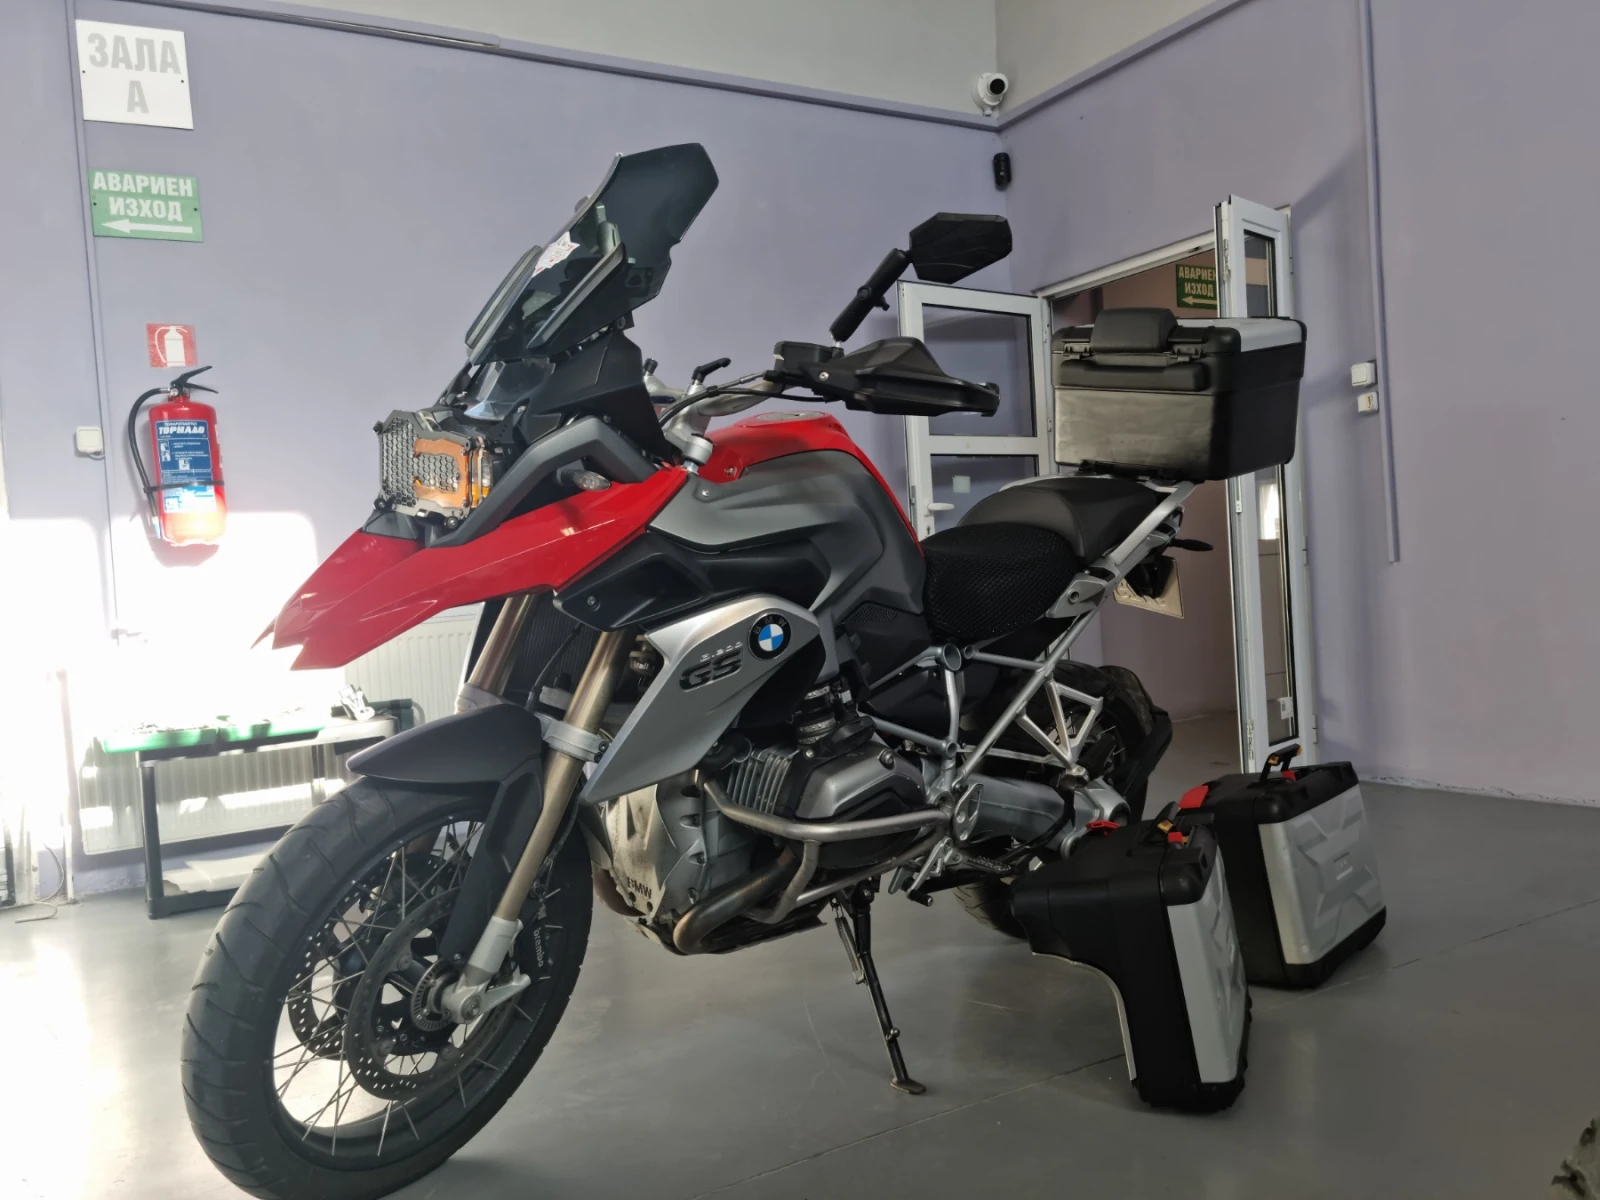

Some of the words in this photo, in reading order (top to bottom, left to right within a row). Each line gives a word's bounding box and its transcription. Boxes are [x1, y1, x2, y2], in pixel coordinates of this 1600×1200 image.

[87, 33, 181, 75] ЗАЛА
[127, 80, 150, 114] А
[93, 172, 193, 197] АВАРИЕН
[108, 196, 183, 222] ИЗХОД
[1184, 282, 1213, 297] ИЗХОД
[159, 426, 205, 434] ТОРНАДО
[680, 650, 742, 691] GS
[626, 876, 652, 900] BMW
[534, 927, 544, 967] brembo
